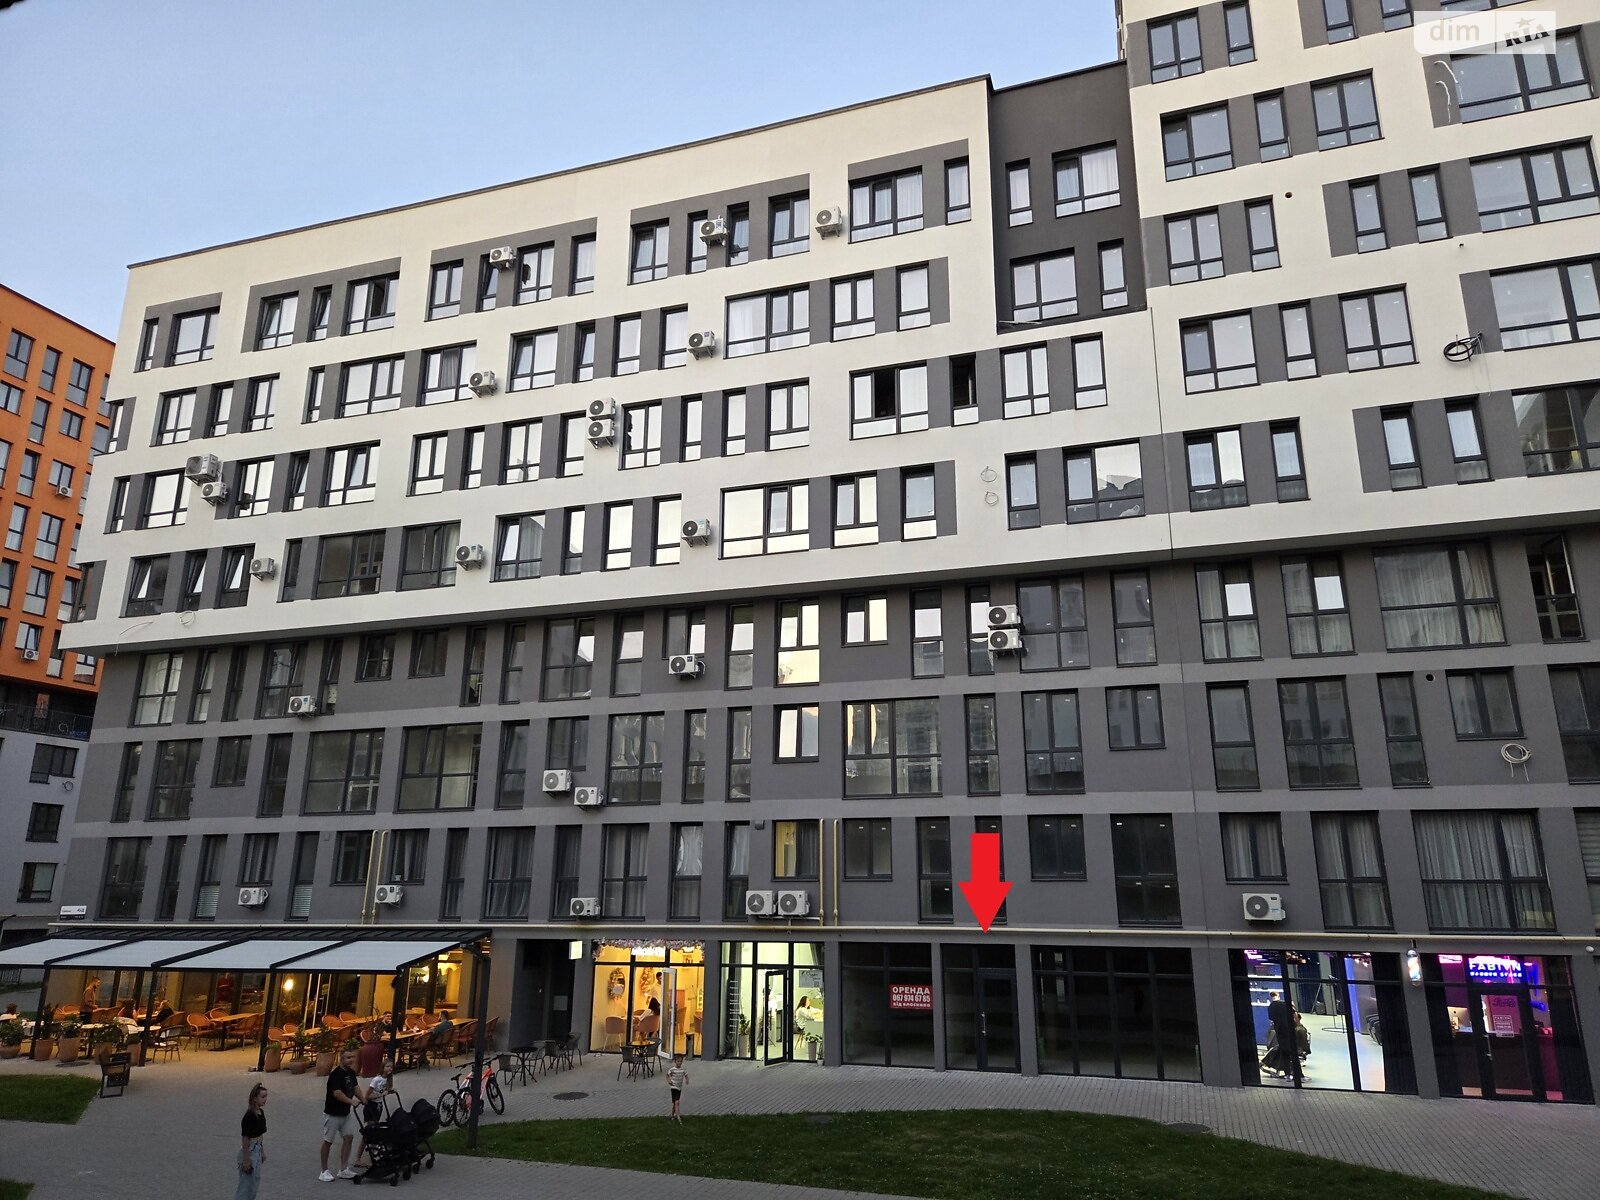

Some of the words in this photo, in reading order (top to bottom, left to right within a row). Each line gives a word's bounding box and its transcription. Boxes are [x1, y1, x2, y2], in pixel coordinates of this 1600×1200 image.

[892, 986, 930, 995] ОРЕНДА
[892, 994, 903, 1002] 067
[915, 994, 922, 1002] 67
